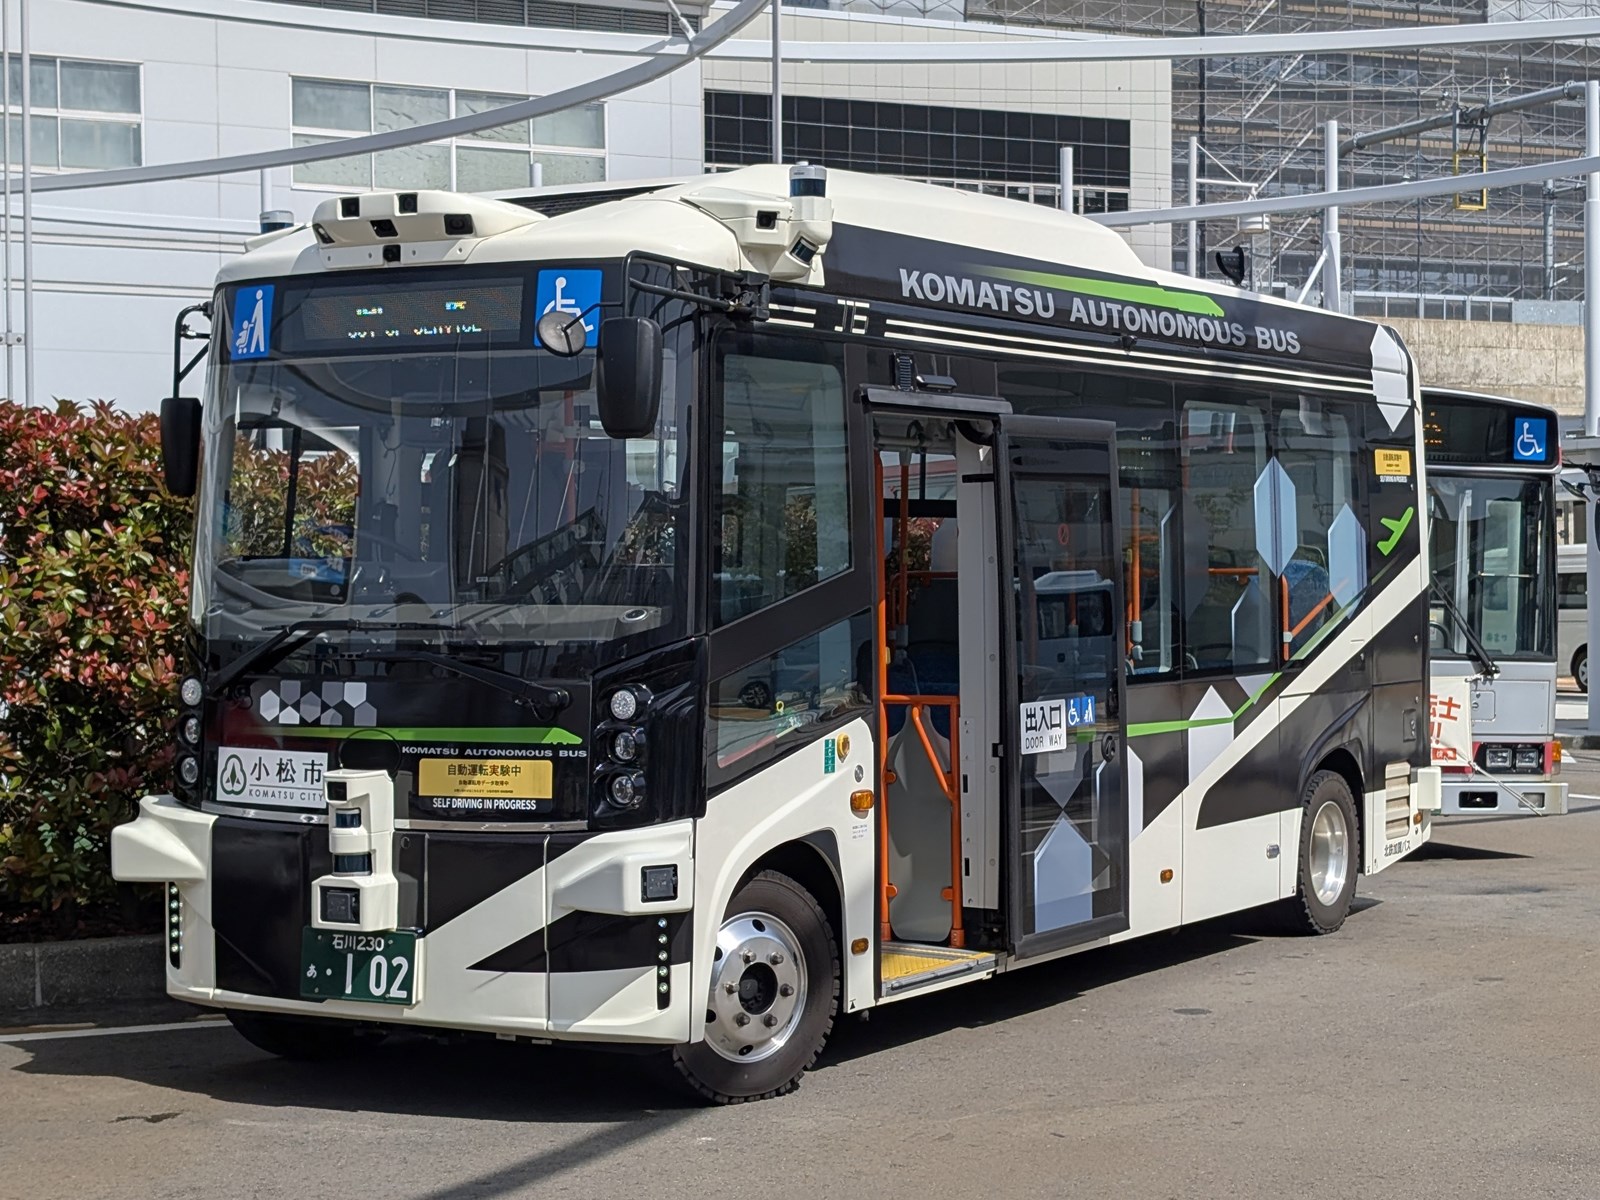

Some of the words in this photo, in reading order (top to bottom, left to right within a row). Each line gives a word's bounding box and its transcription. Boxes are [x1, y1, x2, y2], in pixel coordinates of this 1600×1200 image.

[899, 268, 1055, 319] KOMATSU
[1069, 297, 1247, 347] AUTONOMOUS
[1254, 327, 1301, 355] BUS
[1025, 704, 1062, 733] 出入口
[1025, 735, 1045, 750] DOOR
[1048, 733, 1063, 747] WAY
[402, 746, 459, 756] KOMATSU
[464, 748, 553, 757] AUTONOMOUS
[558, 749, 587, 758] BUS
[249, 756, 324, 785] 小松市
[447, 763, 522, 777] 自動運転実験中
[248, 788, 295, 800] KOMATSU
[299, 791, 324, 802] CITY
[432, 797, 451, 809] SELF
[452, 798, 483, 810] DRIVING
[483, 799, 494, 810] IN
[494, 799, 537, 811] PROGRESS
[332, 934, 385, 951] 石川230
[306, 963, 318, 978] あ
